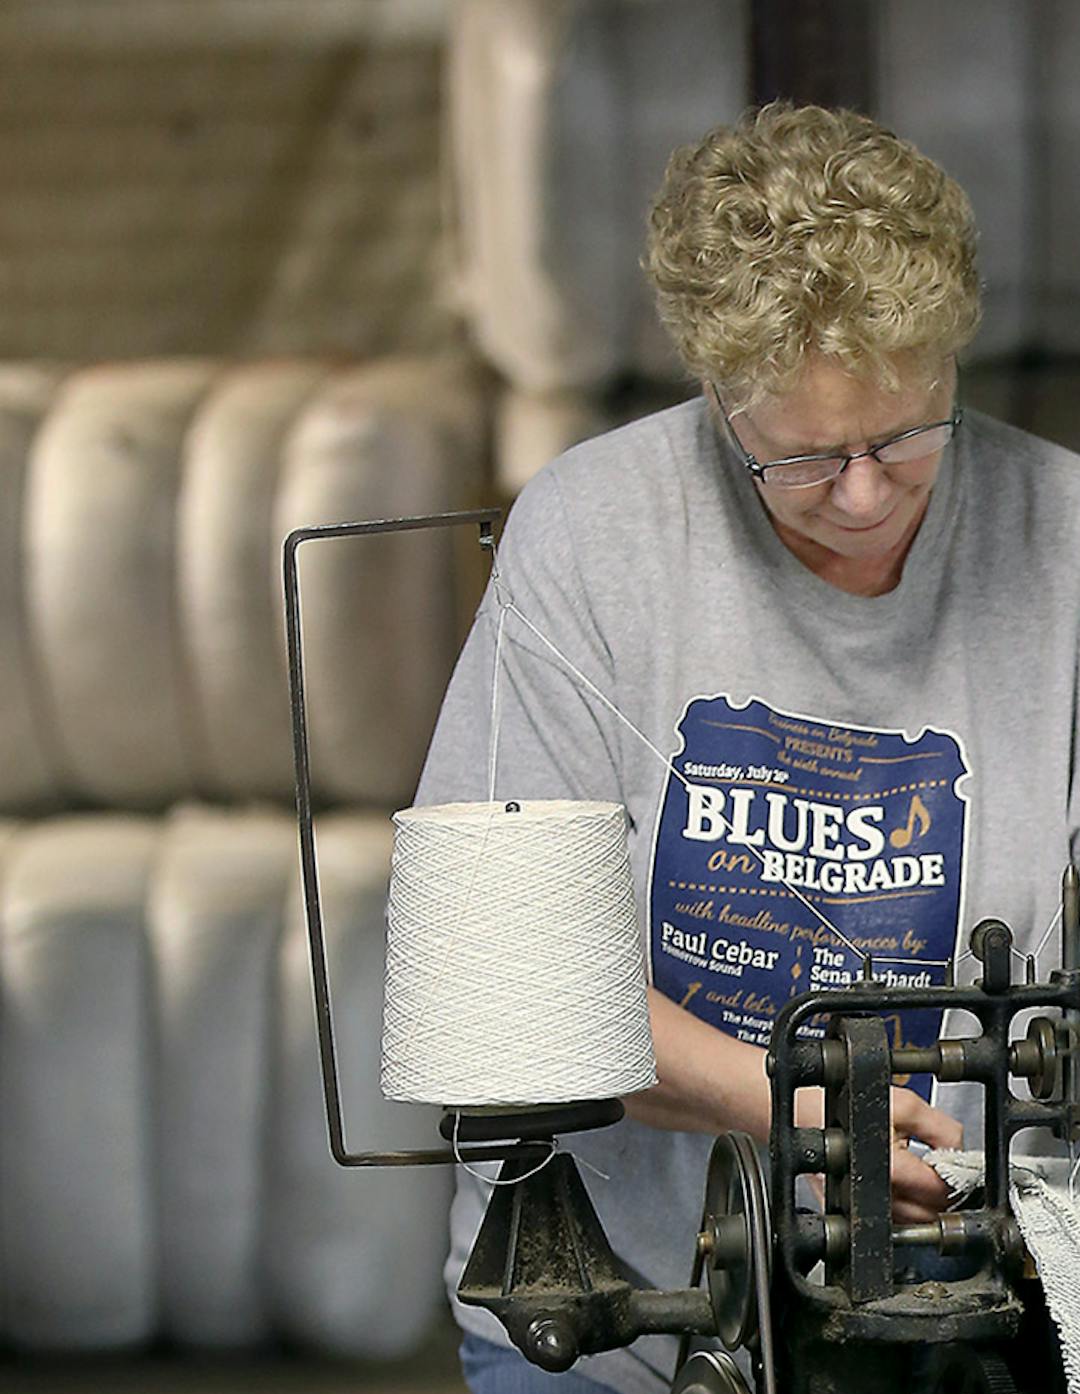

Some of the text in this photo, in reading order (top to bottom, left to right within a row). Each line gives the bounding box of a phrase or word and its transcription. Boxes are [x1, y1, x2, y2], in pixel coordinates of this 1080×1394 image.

[785, 736, 853, 762] PRESENTS
[684, 761, 744, 781] Saturday,
[746, 765, 773, 783] July
[682, 784, 885, 861] BLUES
[707, 849, 945, 893] on BELGRADE
[675, 901, 714, 921] with
[718, 904, 789, 934] headline
[788, 925, 899, 950] performances
[662, 922, 780, 970] Paul Cebar
[709, 959, 744, 977] Sound
[813, 948, 845, 967] The
[810, 965, 851, 984] Sena
[705, 989, 742, 1009] and
[723, 1010, 741, 1025] The
